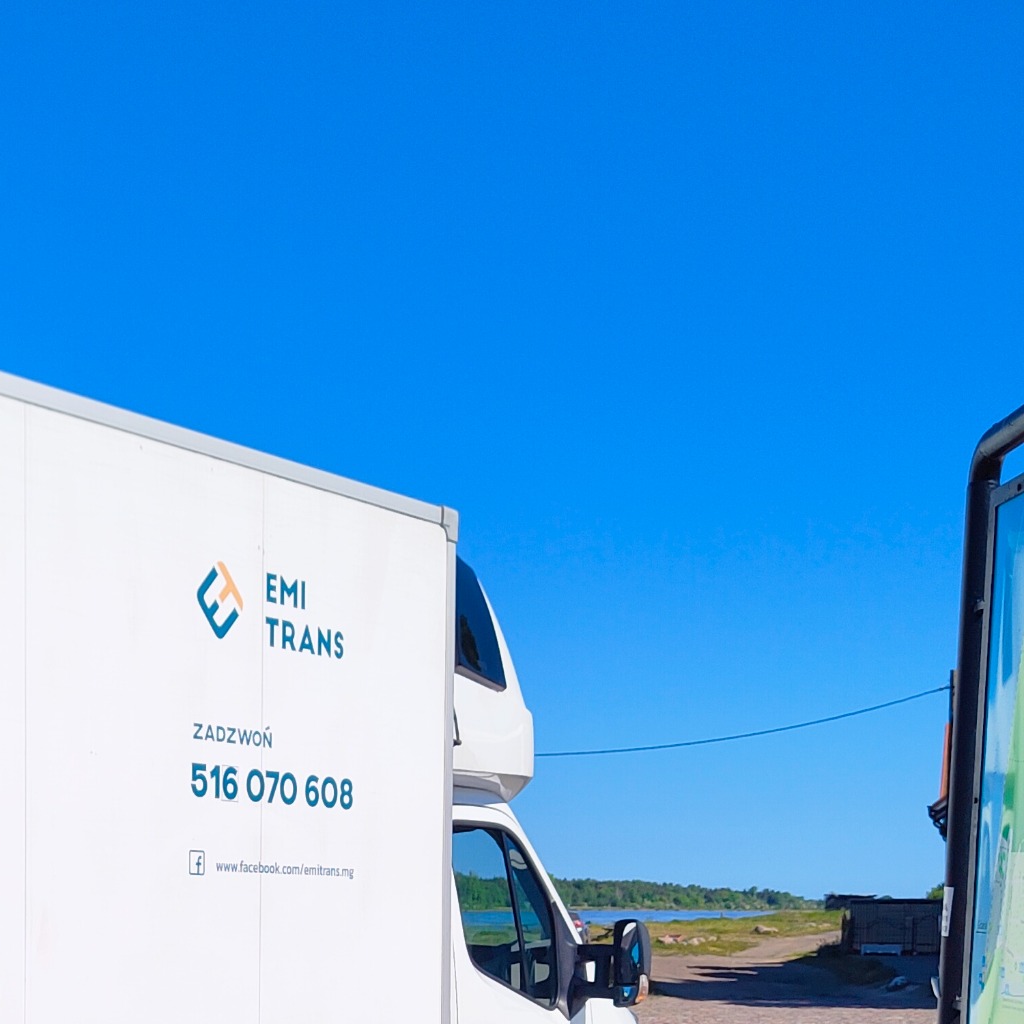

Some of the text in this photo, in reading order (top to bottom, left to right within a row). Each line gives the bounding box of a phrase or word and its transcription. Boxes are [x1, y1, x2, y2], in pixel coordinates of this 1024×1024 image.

[266, 571, 306, 610] EMI
[265, 615, 344, 660] TRANS
[192, 722, 273, 749] ZADZWOŃ
[190, 762, 354, 811] 516 070 608
[215, 860, 355, 880] www.facebook.com/emitrans.mg
